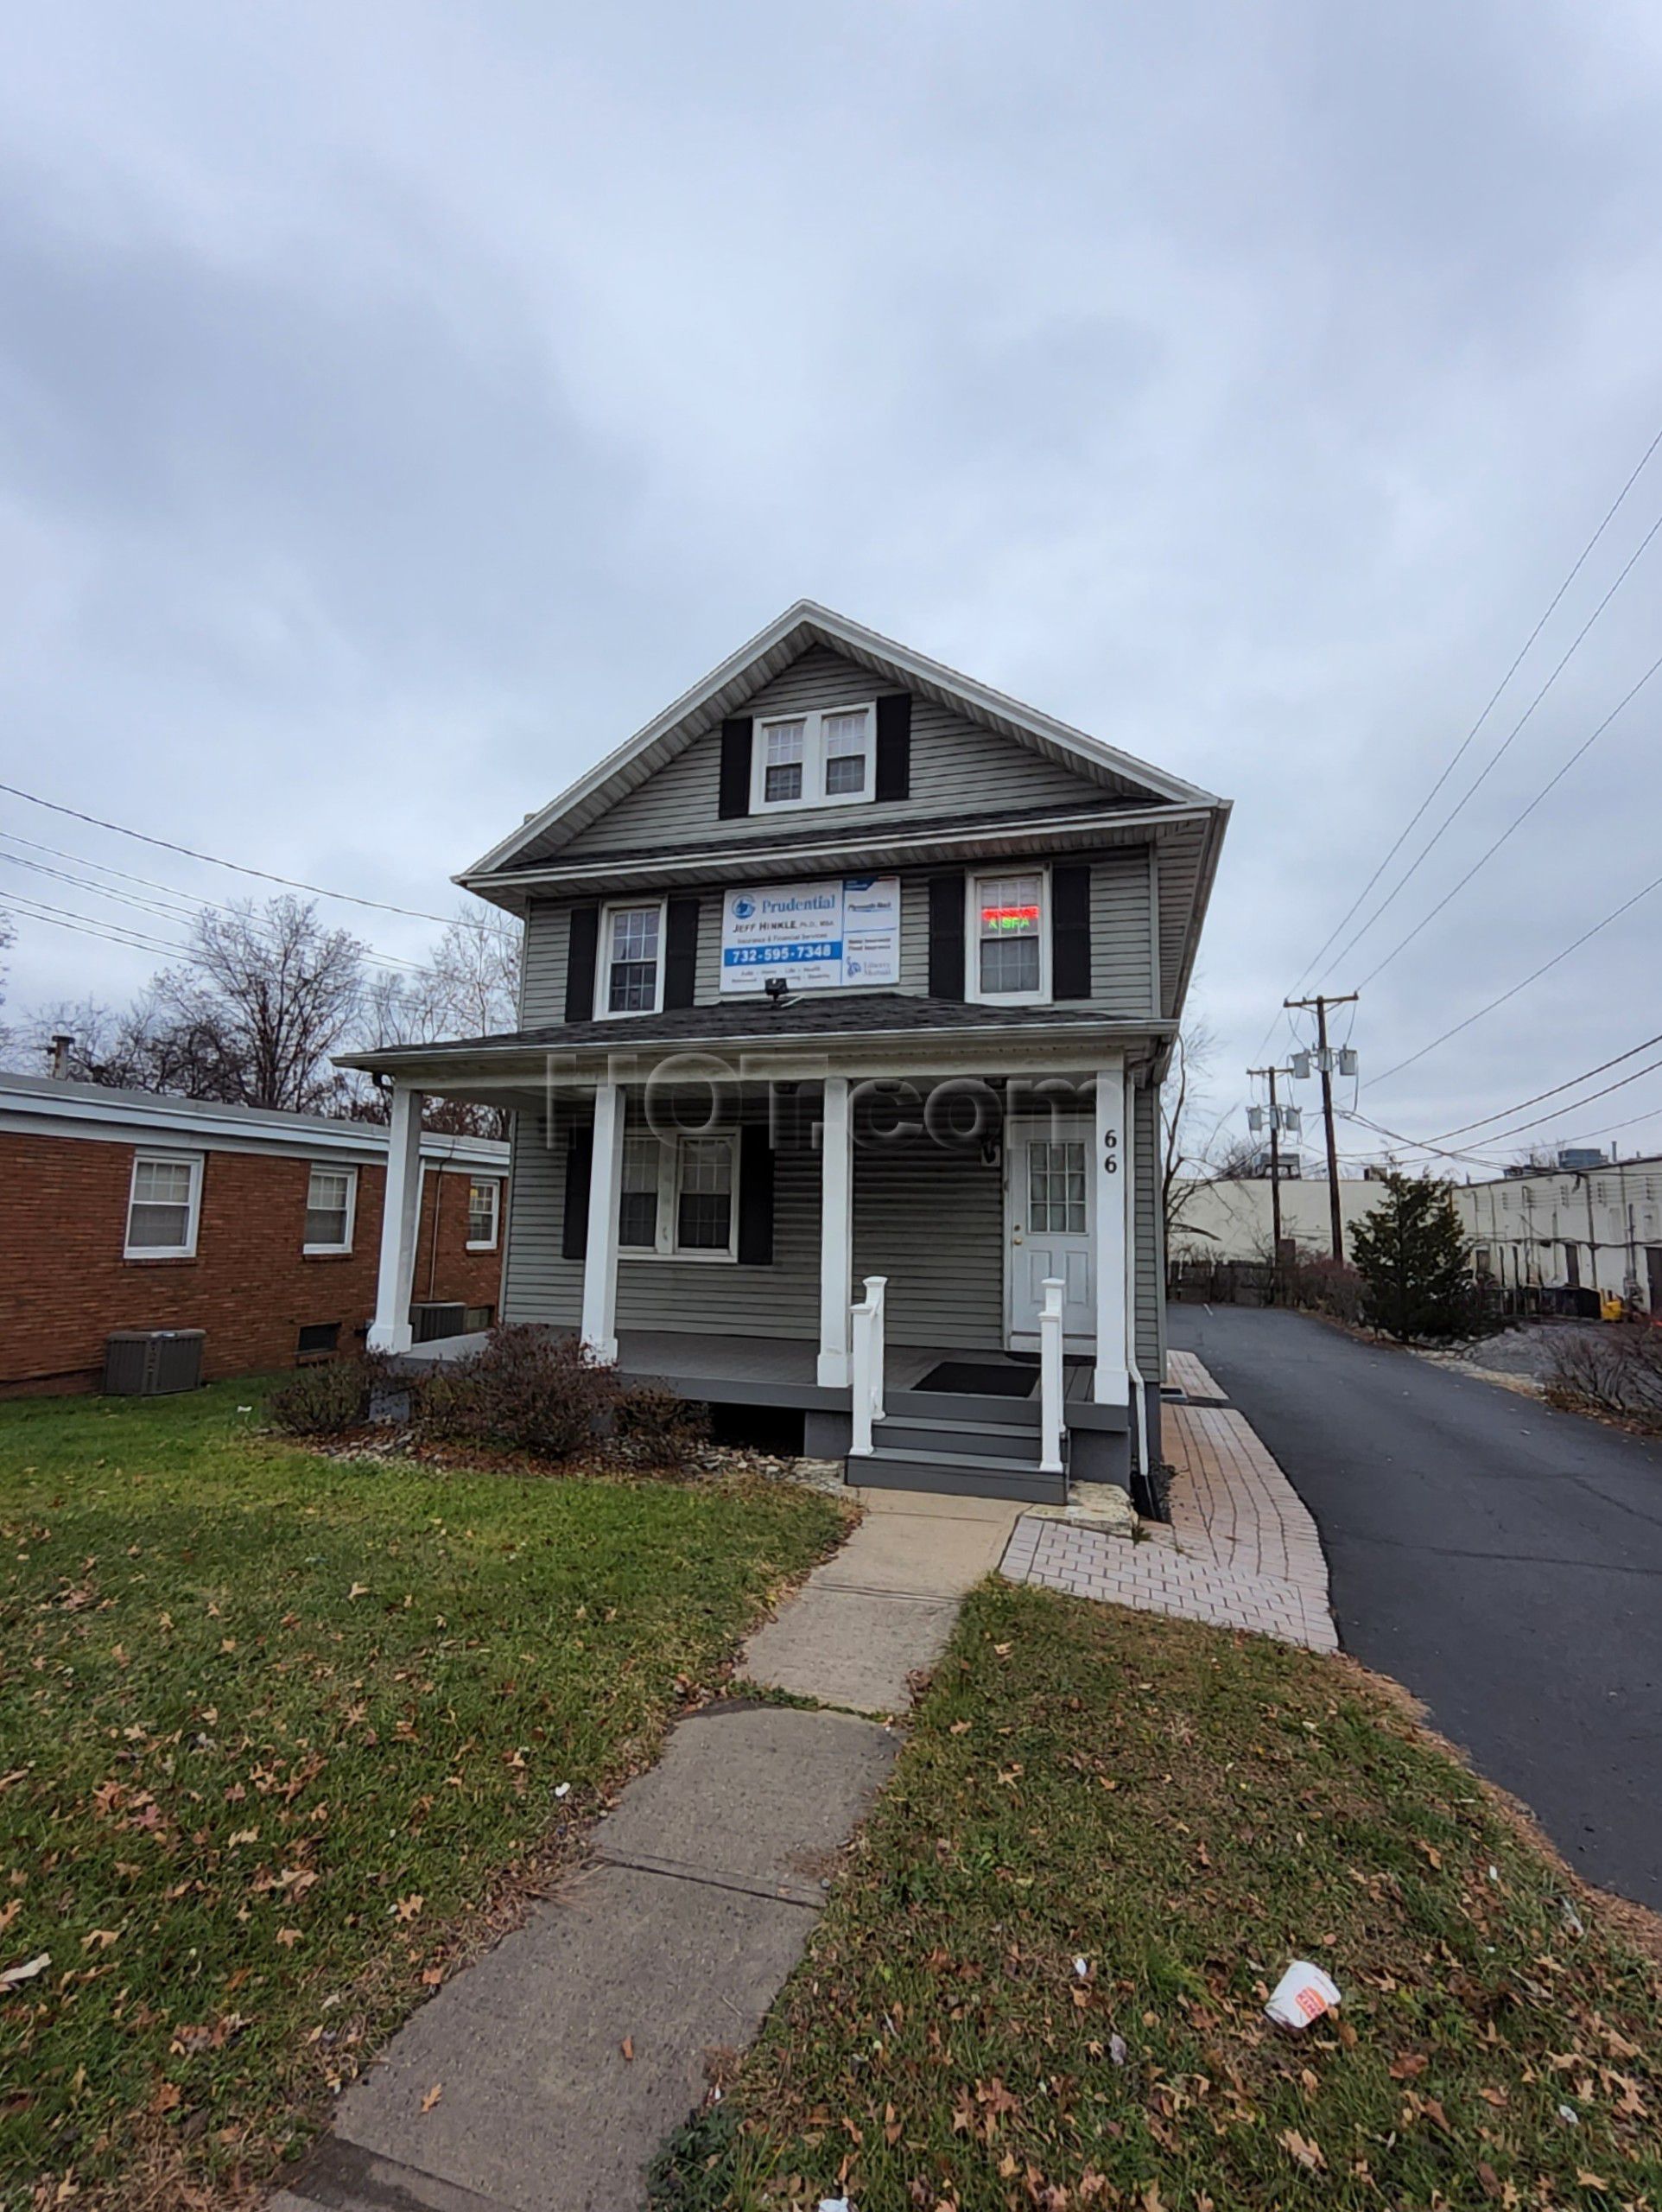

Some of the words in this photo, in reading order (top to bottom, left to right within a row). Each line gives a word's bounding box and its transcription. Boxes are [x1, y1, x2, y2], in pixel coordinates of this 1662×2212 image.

[762, 893, 835, 913] Prudential
[733, 924, 756, 933] JEFF
[733, 944, 831, 963] 732-595-7348
